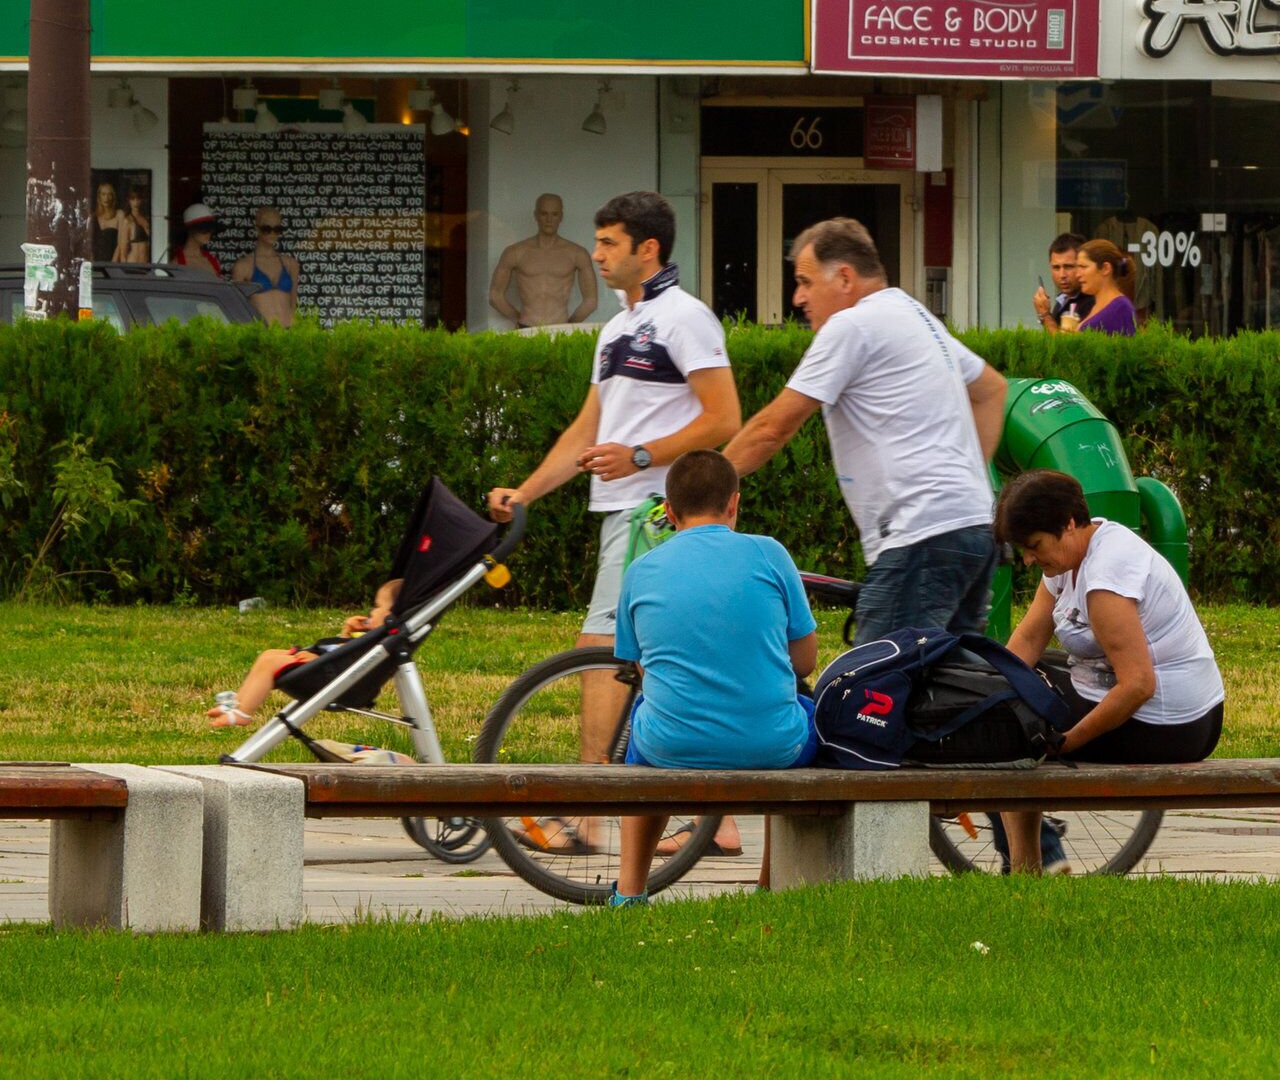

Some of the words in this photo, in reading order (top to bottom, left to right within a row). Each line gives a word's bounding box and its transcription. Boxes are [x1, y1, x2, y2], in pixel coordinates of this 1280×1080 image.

[863, 5, 933, 31] FACE
[944, 6, 962, 31] &
[973, 7, 1038, 33] BODY
[861, 35, 961, 46] COSMETIC
[969, 38, 1038, 49] STUDIO
[790, 116, 822, 149] 66
[204, 141, 217, 150] OF
[278, 141, 292, 150] 100
[295, 141, 328, 150] YEARS
[332, 141, 345, 150] OF
[407, 141, 421, 150] 100
[251, 152, 265, 160] 100
[268, 152, 300, 160] YEARS
[305, 152, 318, 160] OF
[379, 152, 394, 160] 100
[219, 163, 232, 171] OF
[294, 163, 308, 171] 100
[311, 163, 343, 171] YEARS
[347, 163, 360, 171] OF
[212, 174, 245, 183] YEARS
[249, 174, 262, 183] OF
[323, 174, 337, 183] 100
[341, 174, 373, 183] YEARS
[377, 174, 391, 183] OF
[265, 186, 279, 194] 100
[282, 186, 315, 194] YEARS
[319, 186, 332, 194] OF
[394, 186, 408, 194] 100
[203, 197, 216, 205] OF
[277, 197, 291, 205] 100
[294, 197, 327, 205] YEARS
[331, 197, 344, 205] OF
[406, 197, 420, 205] 100
[293, 218, 306, 227] 100
[310, 218, 342, 227] YEARS
[346, 218, 359, 227] OF
[282, 241, 314, 250] YEARS
[318, 241, 331, 250] OF
[394, 241, 408, 250] 100
[1128, 231, 1201, 267] -30%
[294, 253, 327, 261] YEARS
[330, 253, 343, 261] OF
[406, 253, 420, 261] 100
[309, 275, 342, 283] YEARS
[346, 275, 359, 283] OF
[330, 308, 343, 316] OF
[405, 308, 420, 316] 100
[856, 713, 887, 728] PATRICK
